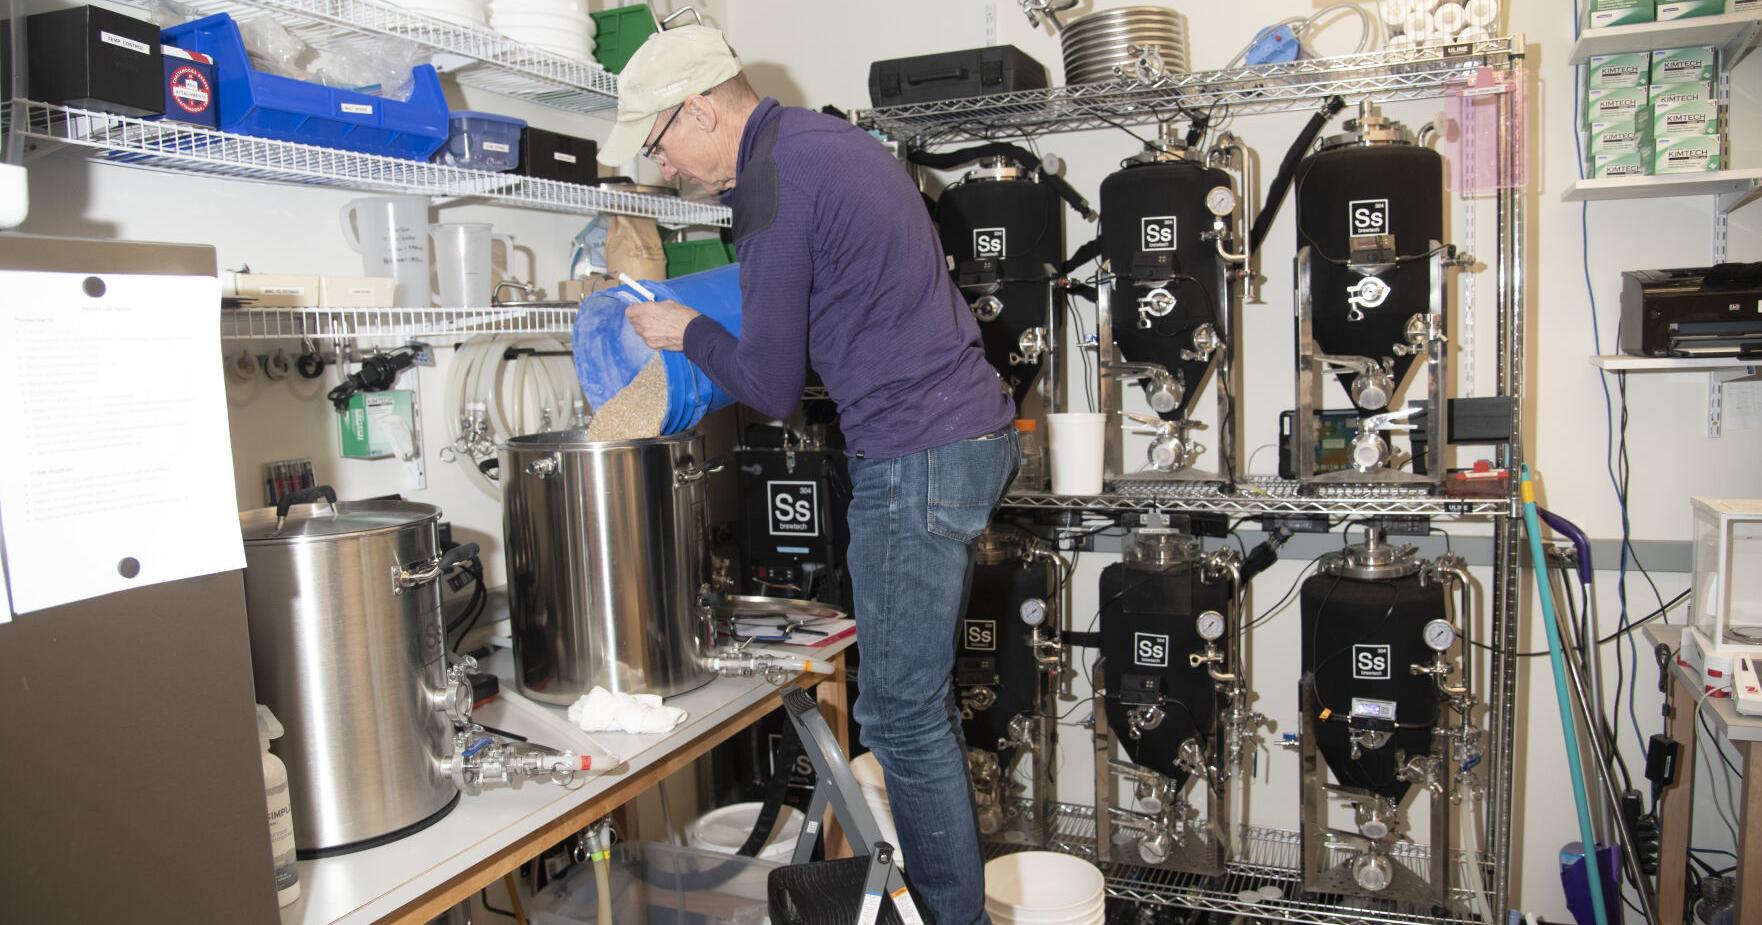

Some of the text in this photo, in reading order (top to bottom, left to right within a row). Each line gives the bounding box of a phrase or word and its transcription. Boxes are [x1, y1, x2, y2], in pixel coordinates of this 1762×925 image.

[107, 35, 120, 43] TEMP
[1602, 66, 1638, 74] KIMTECH
[1664, 60, 1702, 68] KIMTECH
[1660, 95, 1699, 103] KIMTECH
[1669, 150, 1708, 158] KIMTECH
[1355, 208, 1383, 228] Ss
[1146, 224, 1172, 242] Ss
[978, 235, 1001, 252] Ss
[775, 492, 811, 522] Ss
[969, 626, 992, 642] Ss
[1139, 640, 1164, 658] Ss
[1358, 652, 1386, 670] Ss
